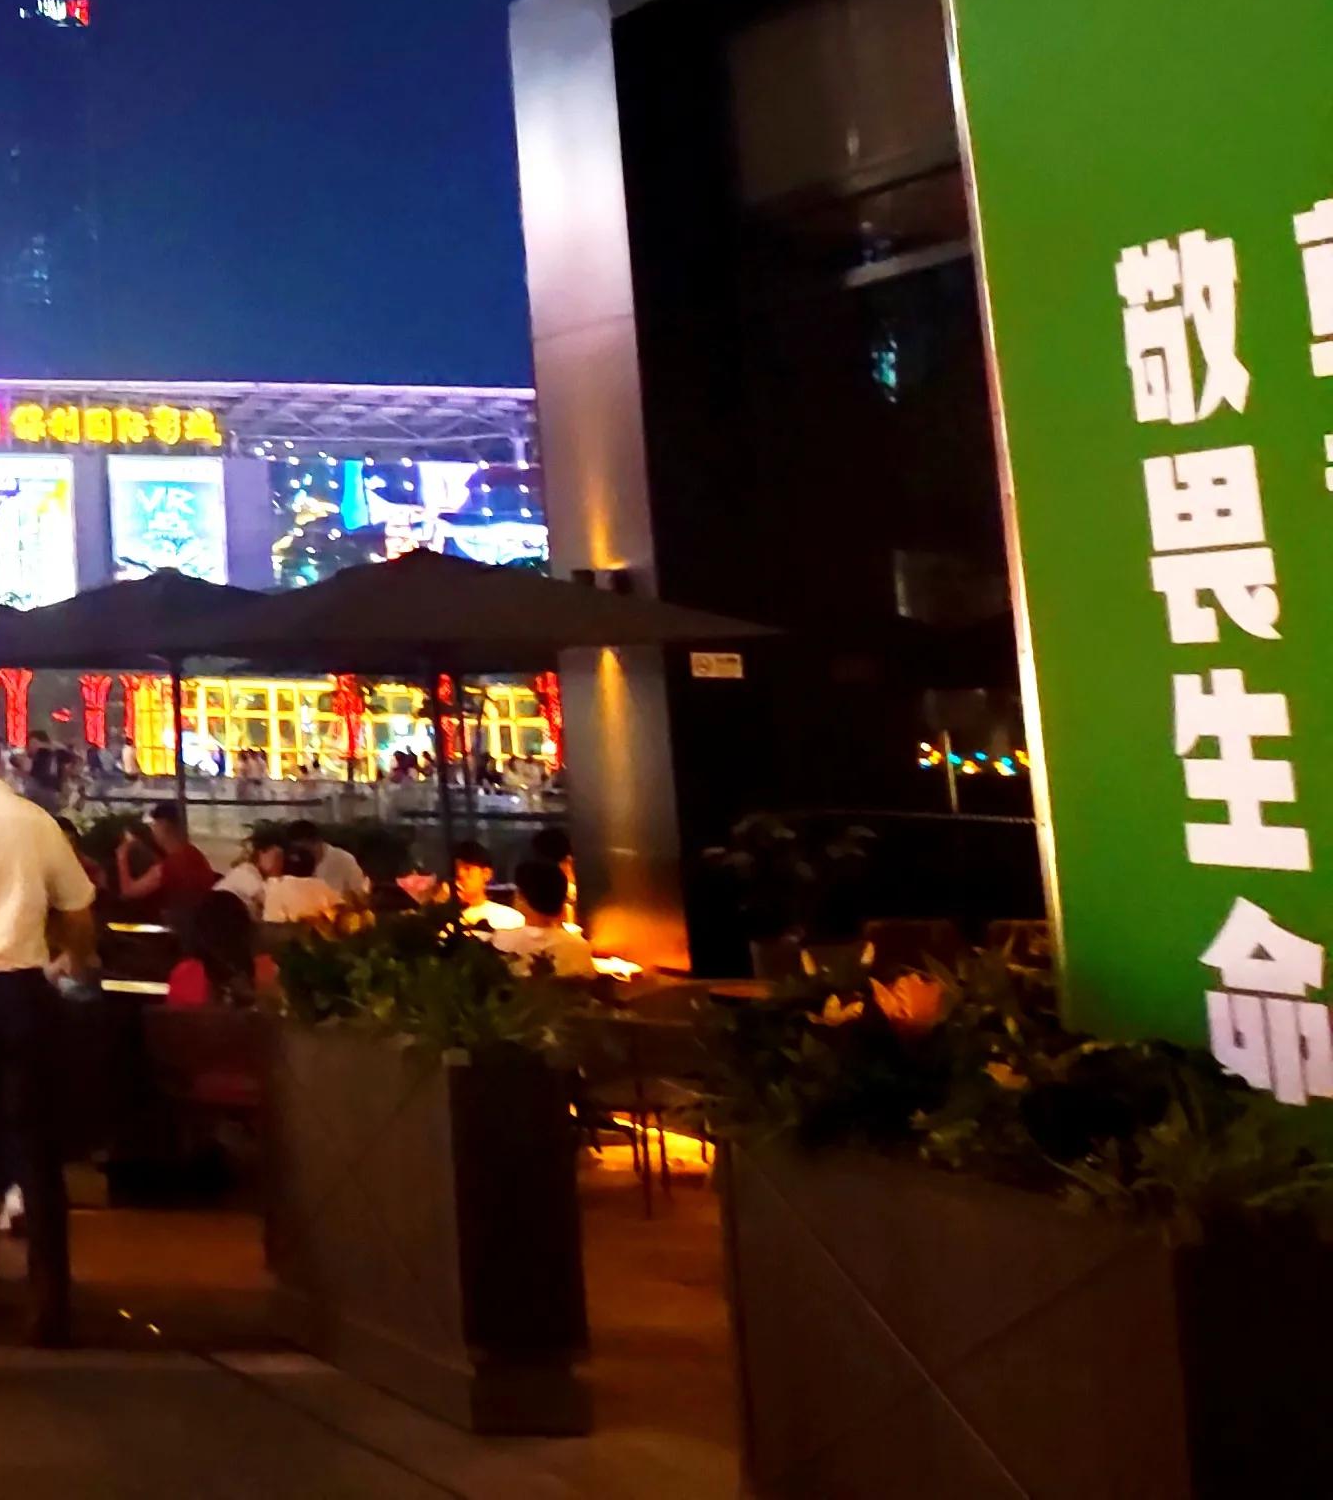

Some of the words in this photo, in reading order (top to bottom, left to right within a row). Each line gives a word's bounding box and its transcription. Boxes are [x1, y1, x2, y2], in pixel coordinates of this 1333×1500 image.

[9, 403, 223, 447] 保利国际影城
[1115, 228, 1333, 1108] 敬畏生命
